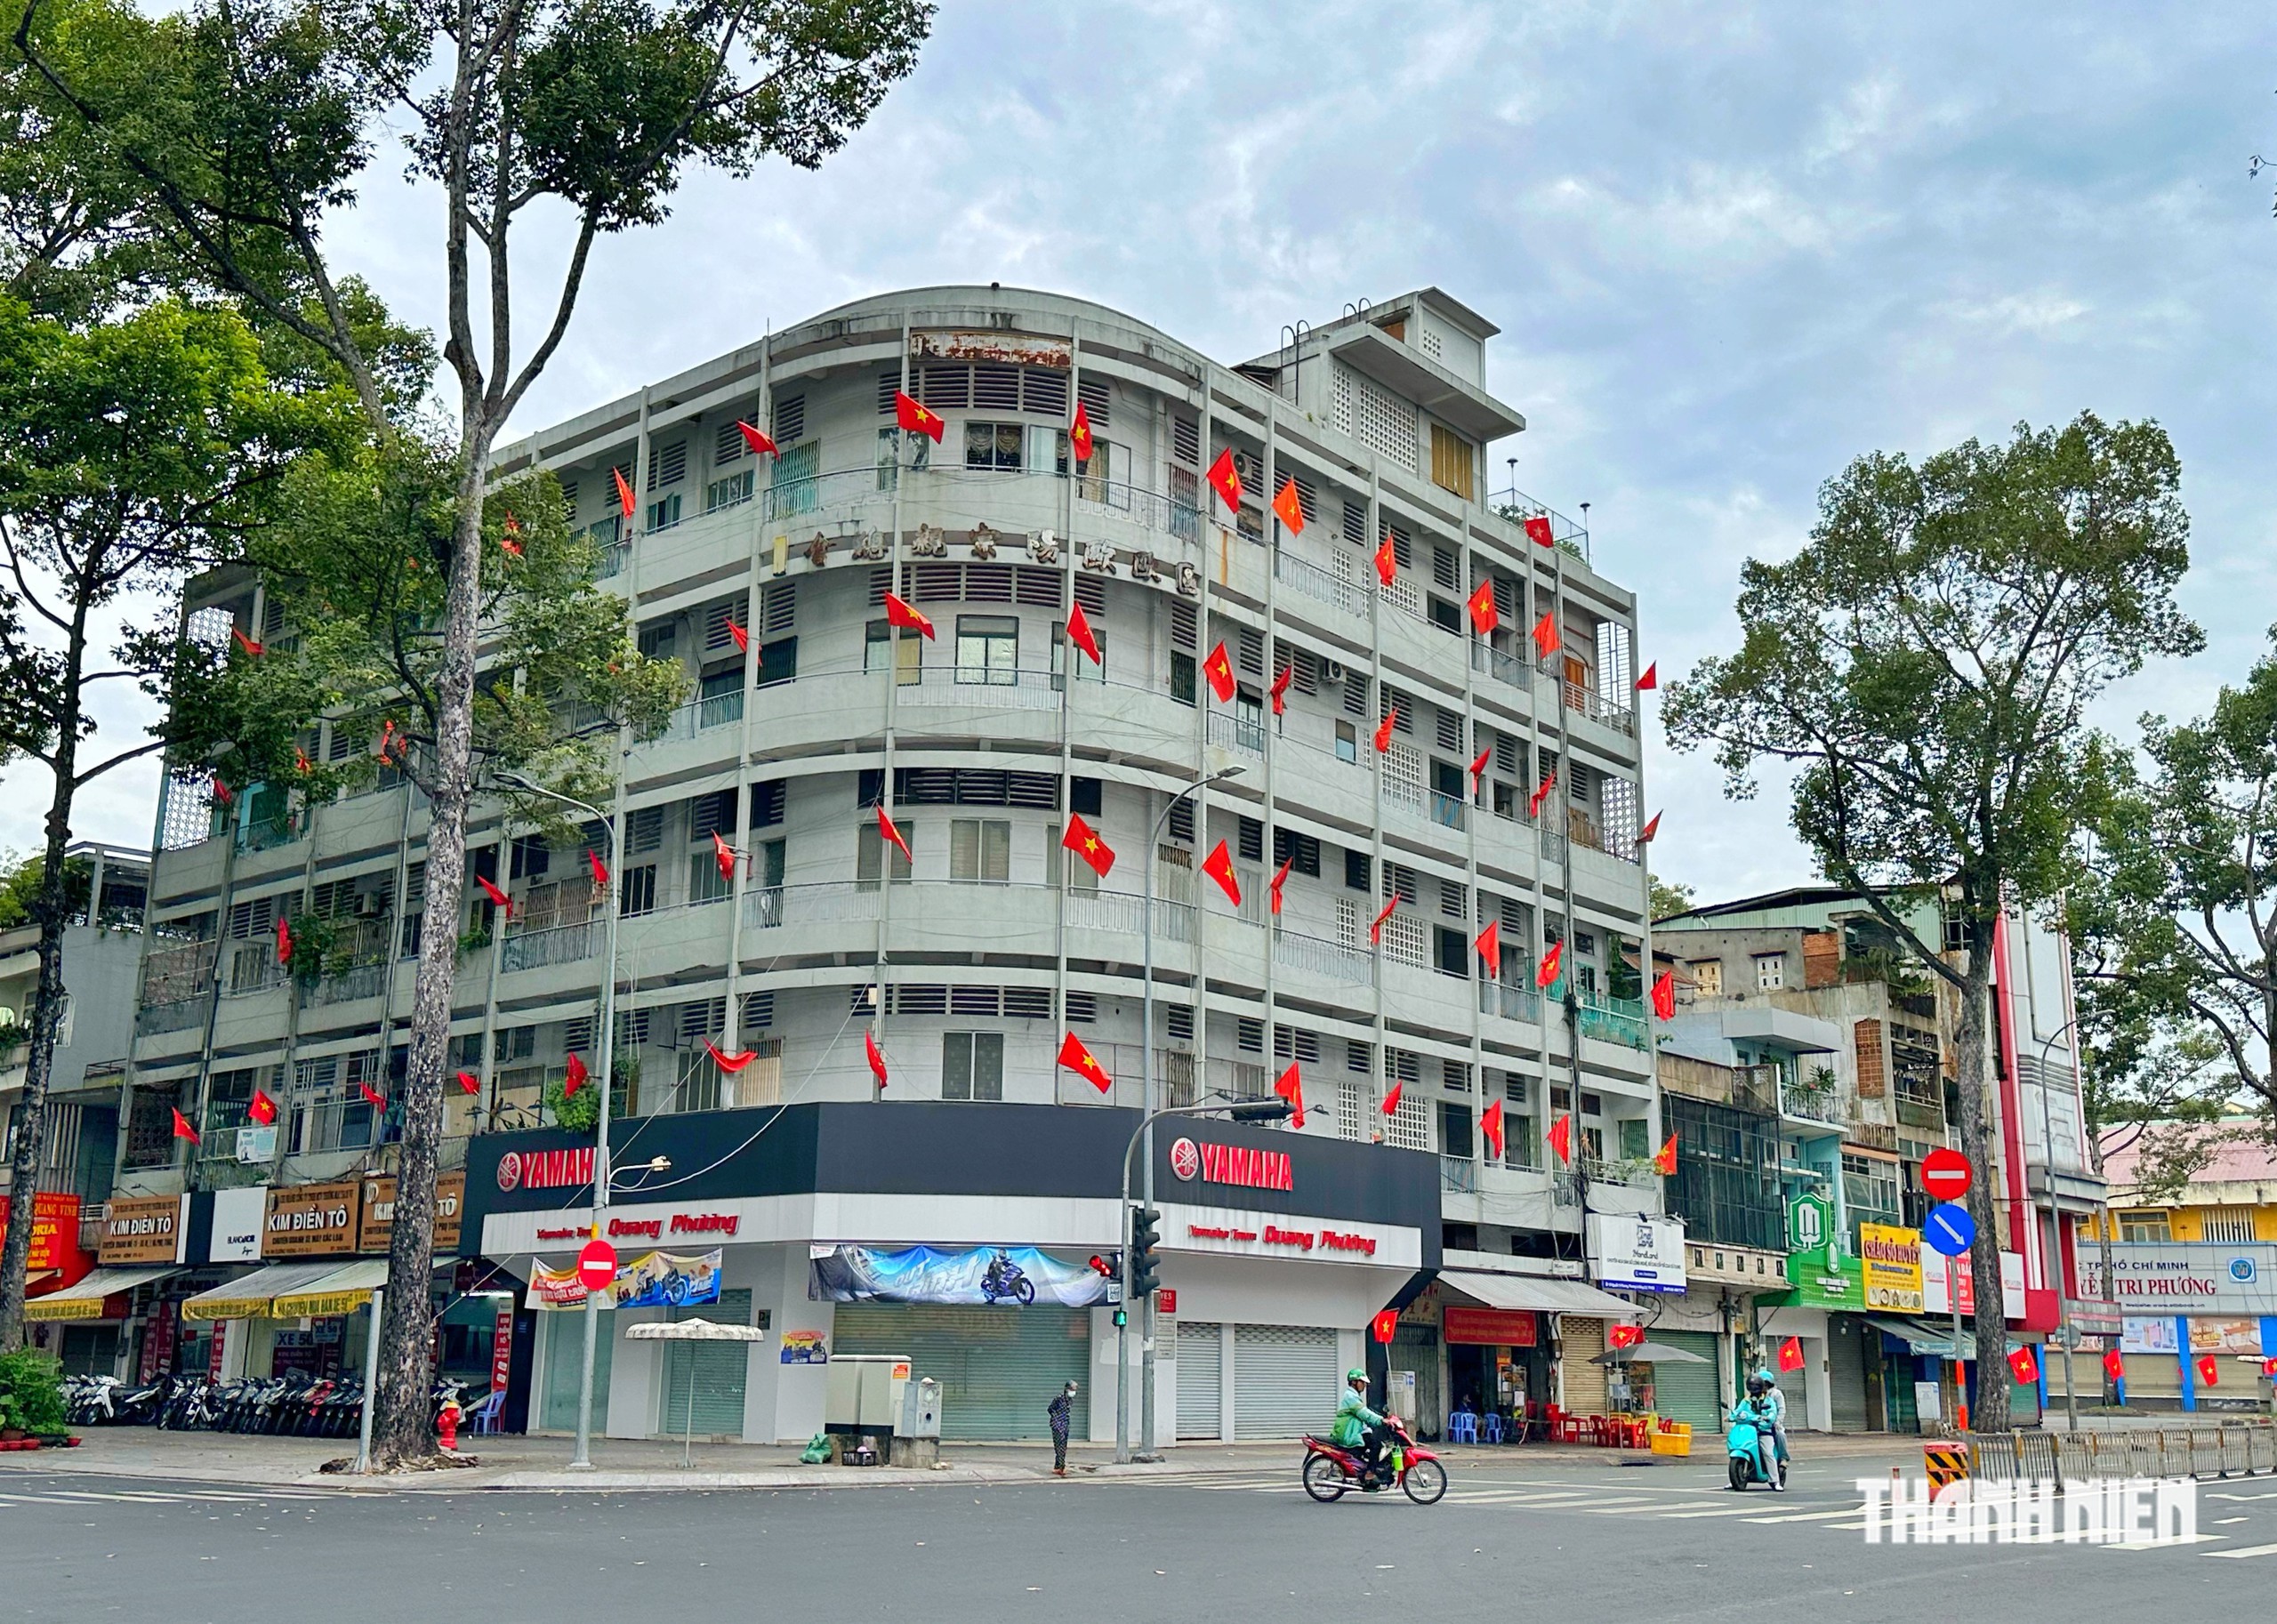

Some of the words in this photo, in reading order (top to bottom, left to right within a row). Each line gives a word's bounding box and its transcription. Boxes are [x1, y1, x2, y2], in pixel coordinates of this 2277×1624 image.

[522, 1145, 611, 1189] YAMAH
[1199, 1143, 1293, 1191] YAMAHA
[34, 1202, 57, 1216] QUANG
[60, 1205, 77, 1217] VINH
[268, 1213, 290, 1231] KIM
[294, 1203, 325, 1230] ĐIỀN
[328, 1203, 347, 1228] TÔ
[437, 1192, 457, 1217] TÔ
[109, 1219, 129, 1236] KIM
[131, 1214, 155, 1234] ĐIỀN
[157, 1211, 172, 1234] TÔ
[607, 1218, 664, 1239] Quang
[670, 1213, 740, 1236] Phương
[1262, 1225, 1315, 1250] Quang
[2132, 1260, 2153, 1270] CHÍ
[2157, 1261, 2189, 1270] MINH
[1160, 1291, 1172, 1300] YES
[2115, 1279, 2143, 1295] TRI
[2147, 1276, 2217, 1295] PHƯƠNG
[278, 1332, 295, 1346] XE
[298, 1332, 314, 1346] 50
